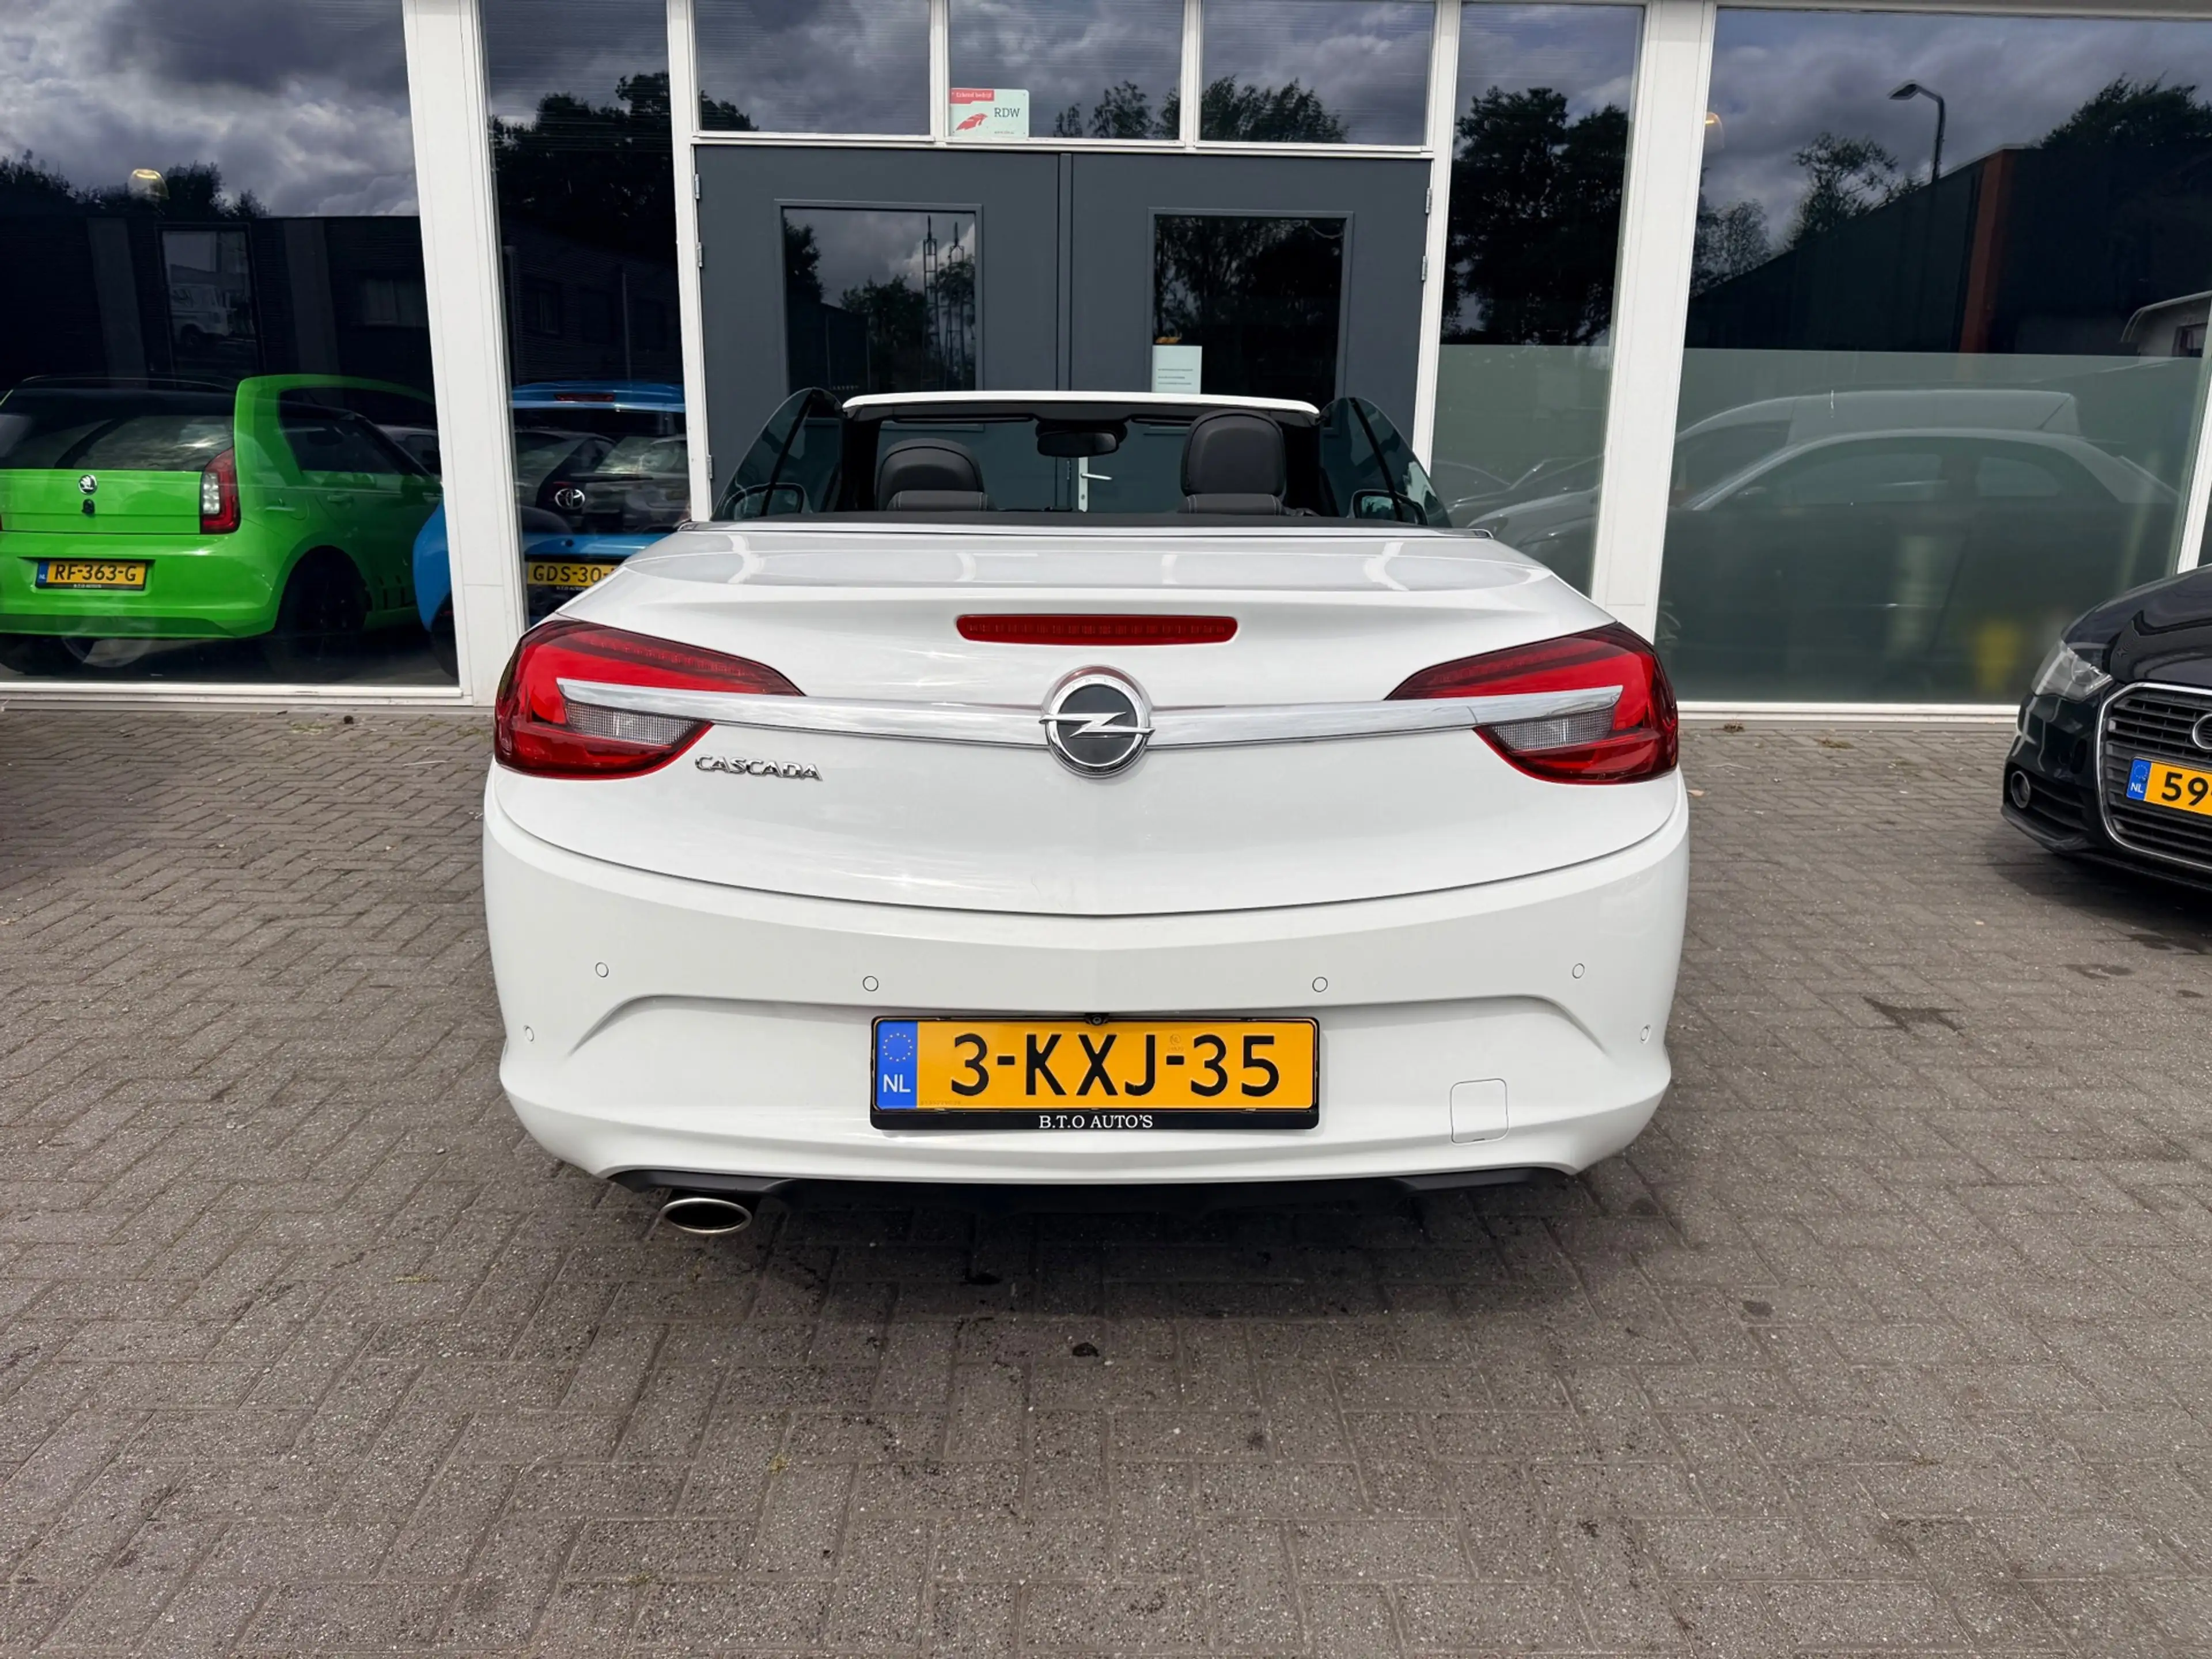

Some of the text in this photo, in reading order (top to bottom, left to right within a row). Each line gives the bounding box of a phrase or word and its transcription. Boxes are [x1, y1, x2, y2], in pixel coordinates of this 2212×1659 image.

[994, 108, 1020, 118] RDW
[55, 564, 137, 581] RF-363-G
[533, 565, 616, 584] GDS-30-
[695, 755, 823, 781] CASCADA
[2130, 782, 2143, 793] NL
[2161, 771, 2212, 806] 59
[950, 1033, 1280, 1097] 3-KXJ-35
[882, 1074, 911, 1093] NL
[1039, 1115, 1153, 1128] B.T.O AUTO'S
